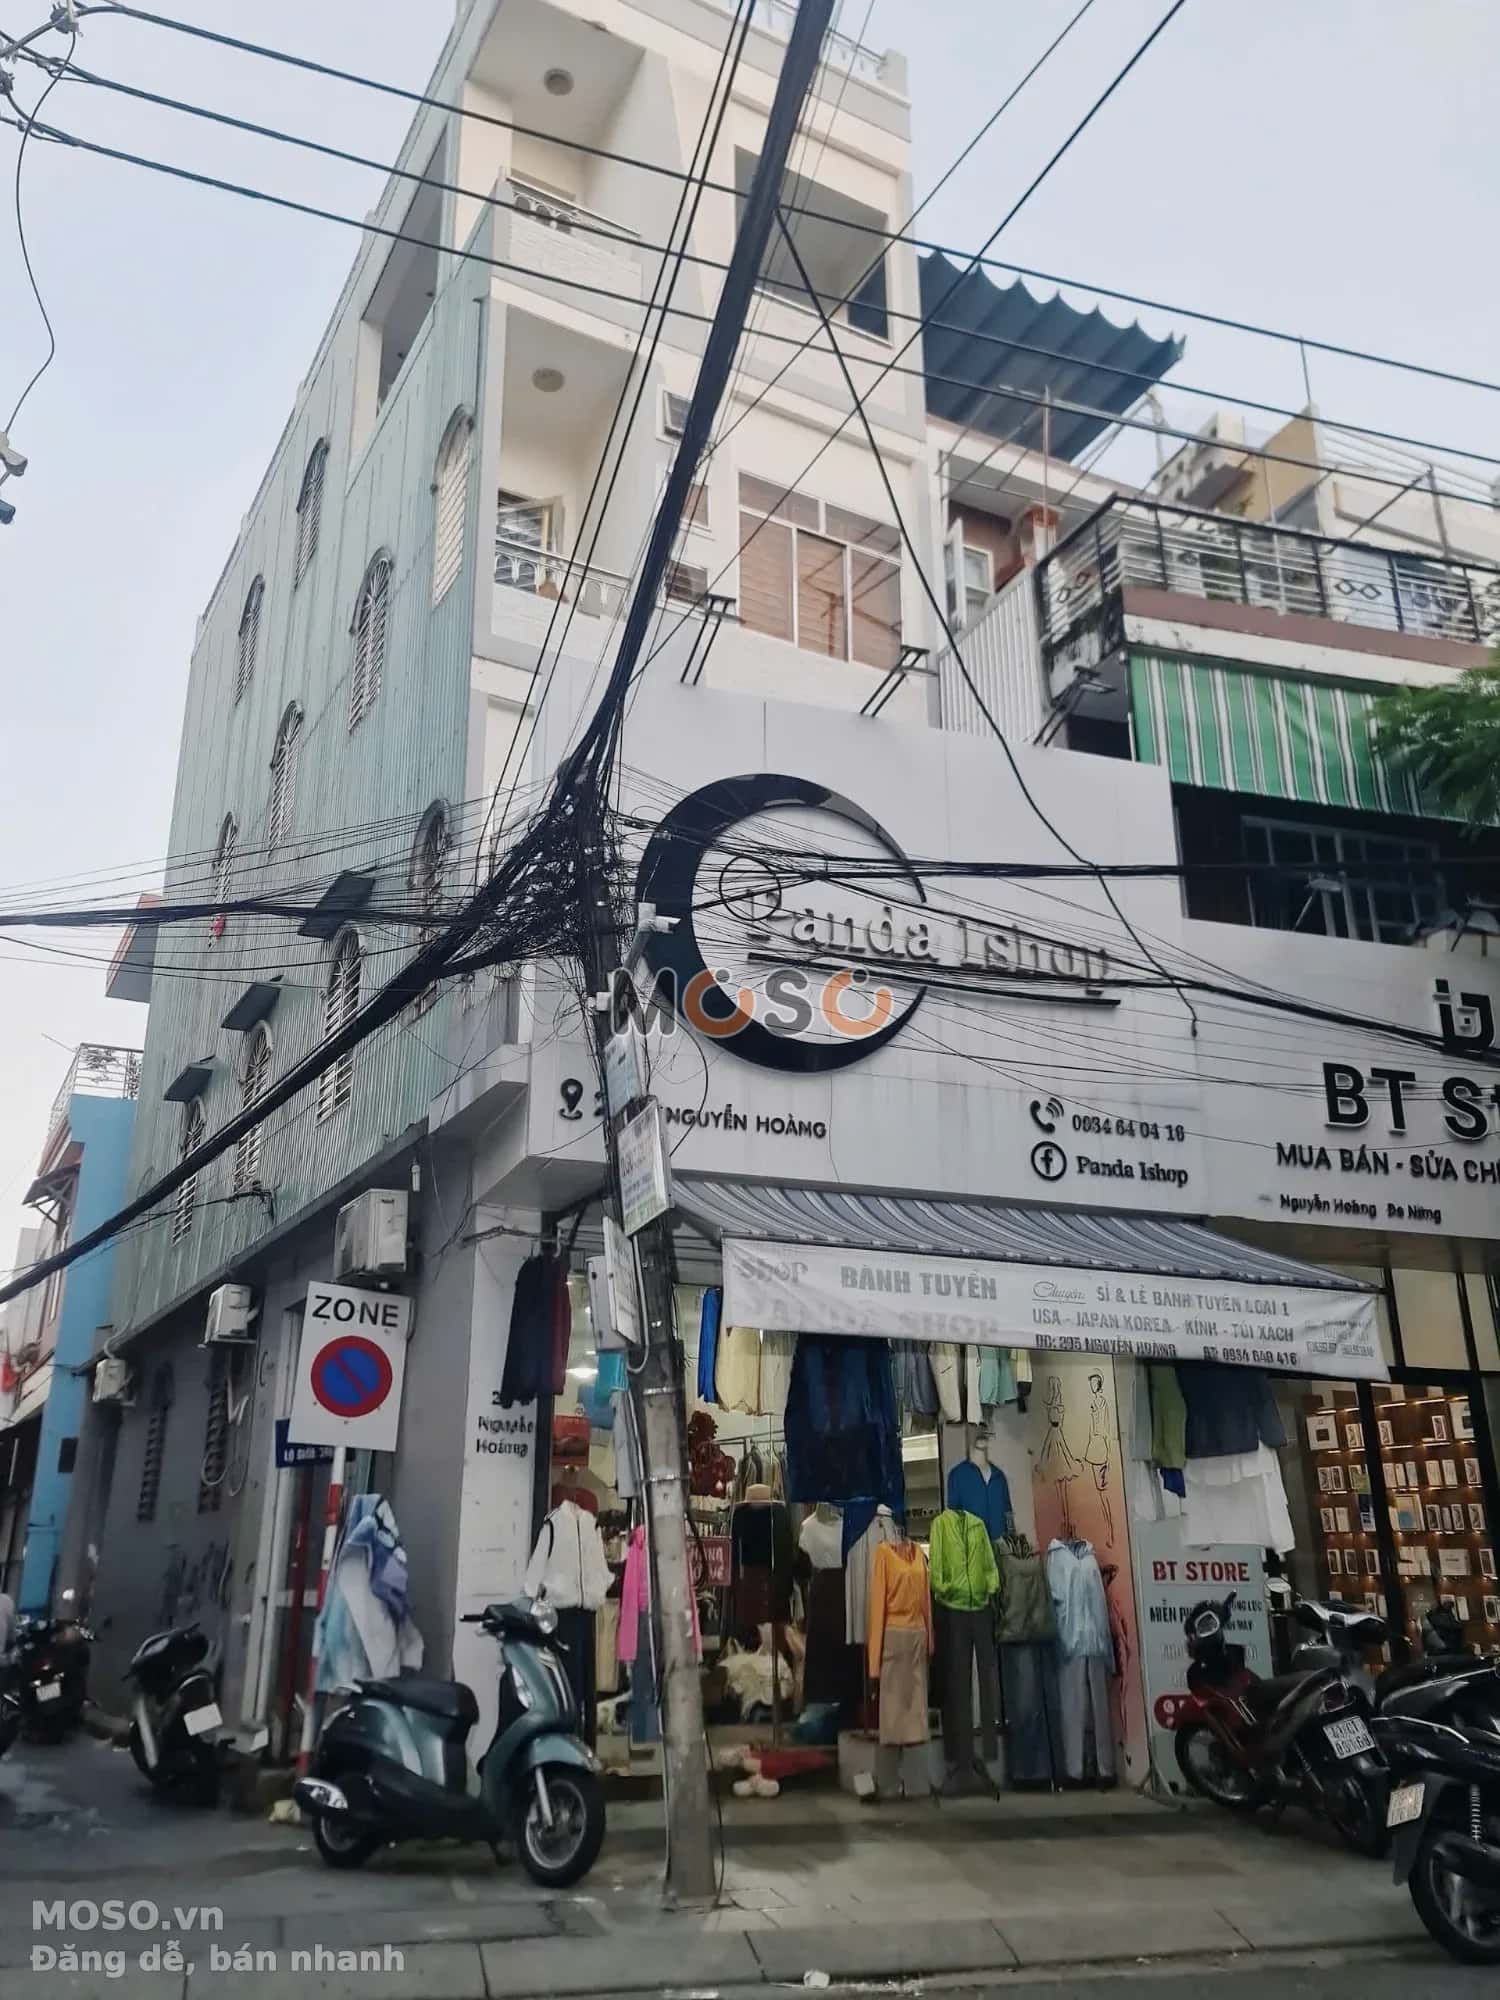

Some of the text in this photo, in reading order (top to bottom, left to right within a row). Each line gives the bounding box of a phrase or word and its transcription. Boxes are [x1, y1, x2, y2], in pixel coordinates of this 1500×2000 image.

[746, 888, 938, 963] Panda
[1322, 1062, 1416, 1132] BT
[666, 1104, 827, 1139] NGUYỄN HOÀNG
[1116, 1119, 1136, 1138] 64
[1076, 1155, 1189, 1188] Panda Ishop
[1276, 1142, 1331, 1171] MUA
[1340, 1144, 1389, 1175] BÁN
[1410, 1149, 1459, 1181] SỬA
[311, 1294, 400, 1328] ZONE
[1115, 1287, 1126, 1303] &
[1277, 1302, 1290, 1317] 1
[1032, 1308, 1062, 1326] USA
[1076, 1311, 1120, 1329] JAPAN
[1123, 1314, 1171, 1333] KOREA
[1184, 1316, 1218, 1337] KÍNH
[1231, 1320, 1254, 1340] TÚI
[1258, 1322, 1294, 1342] XÁCH
[1276, 1351, 1297, 1366] 416
[1152, 1560, 1251, 1582] BT STORE
